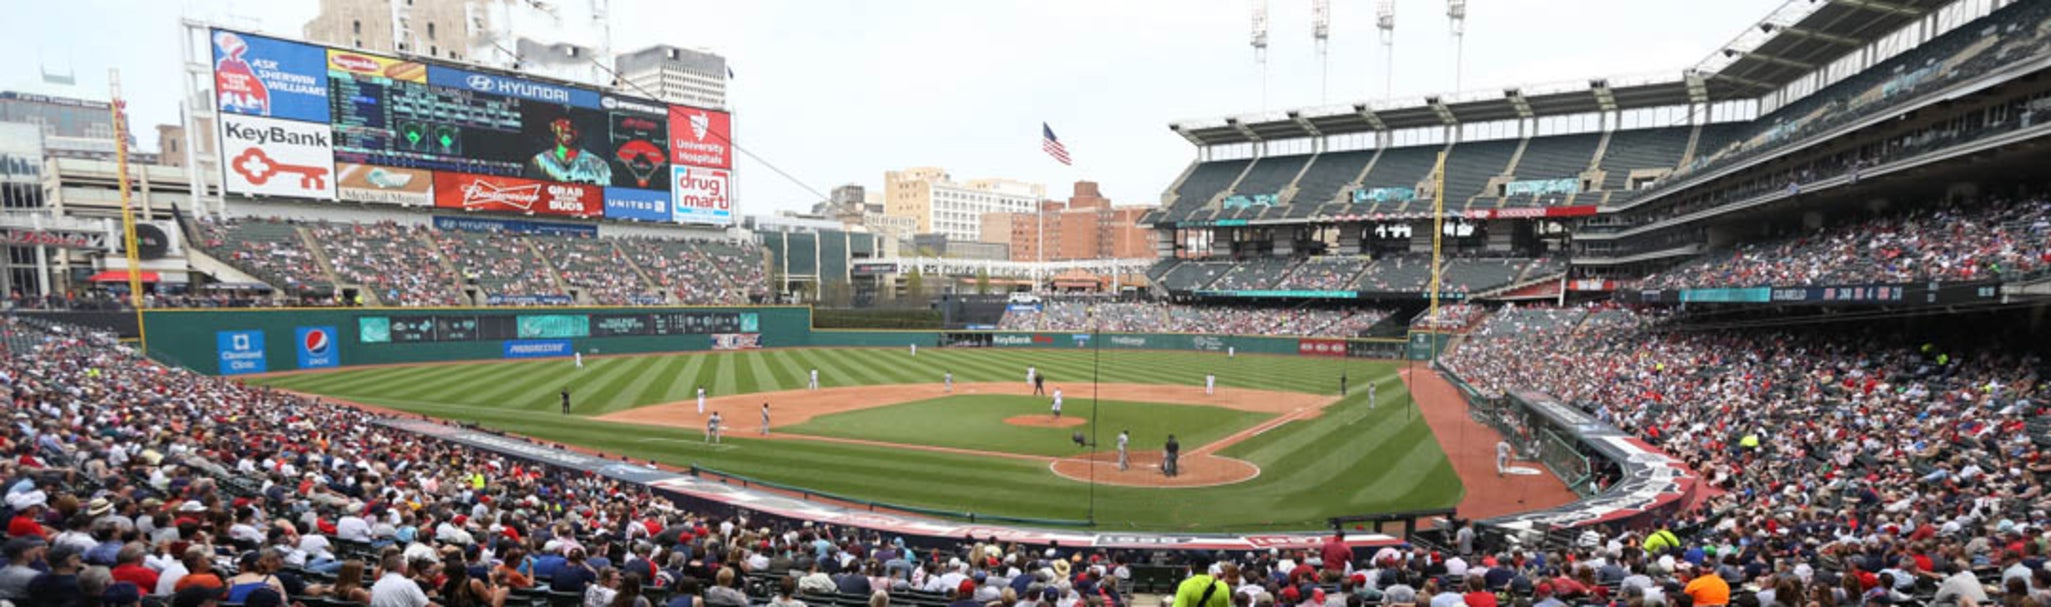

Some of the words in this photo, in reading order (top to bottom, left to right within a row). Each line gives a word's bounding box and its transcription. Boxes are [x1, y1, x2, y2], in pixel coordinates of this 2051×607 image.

[253, 59, 278, 69] ASK
[259, 70, 316, 85] SHERWIN
[268, 81, 327, 96] WILLIAMS
[499, 81, 569, 102] HYUNDAI
[225, 121, 329, 148] KeyBank
[676, 139, 723, 156] University
[678, 151, 722, 164] Hospitals
[680, 168, 719, 196] drug
[344, 189, 389, 201] Medical
[460, 184, 539, 204] Budweiser
[548, 185, 583, 197] GRAB
[549, 200, 584, 211] BUDS
[608, 198, 653, 209] UNITED
[684, 193, 729, 209] mart
[993, 335, 1032, 346] KeyBank
[221, 350, 263, 360] Cleveland
[230, 359, 256, 369] Clinic
